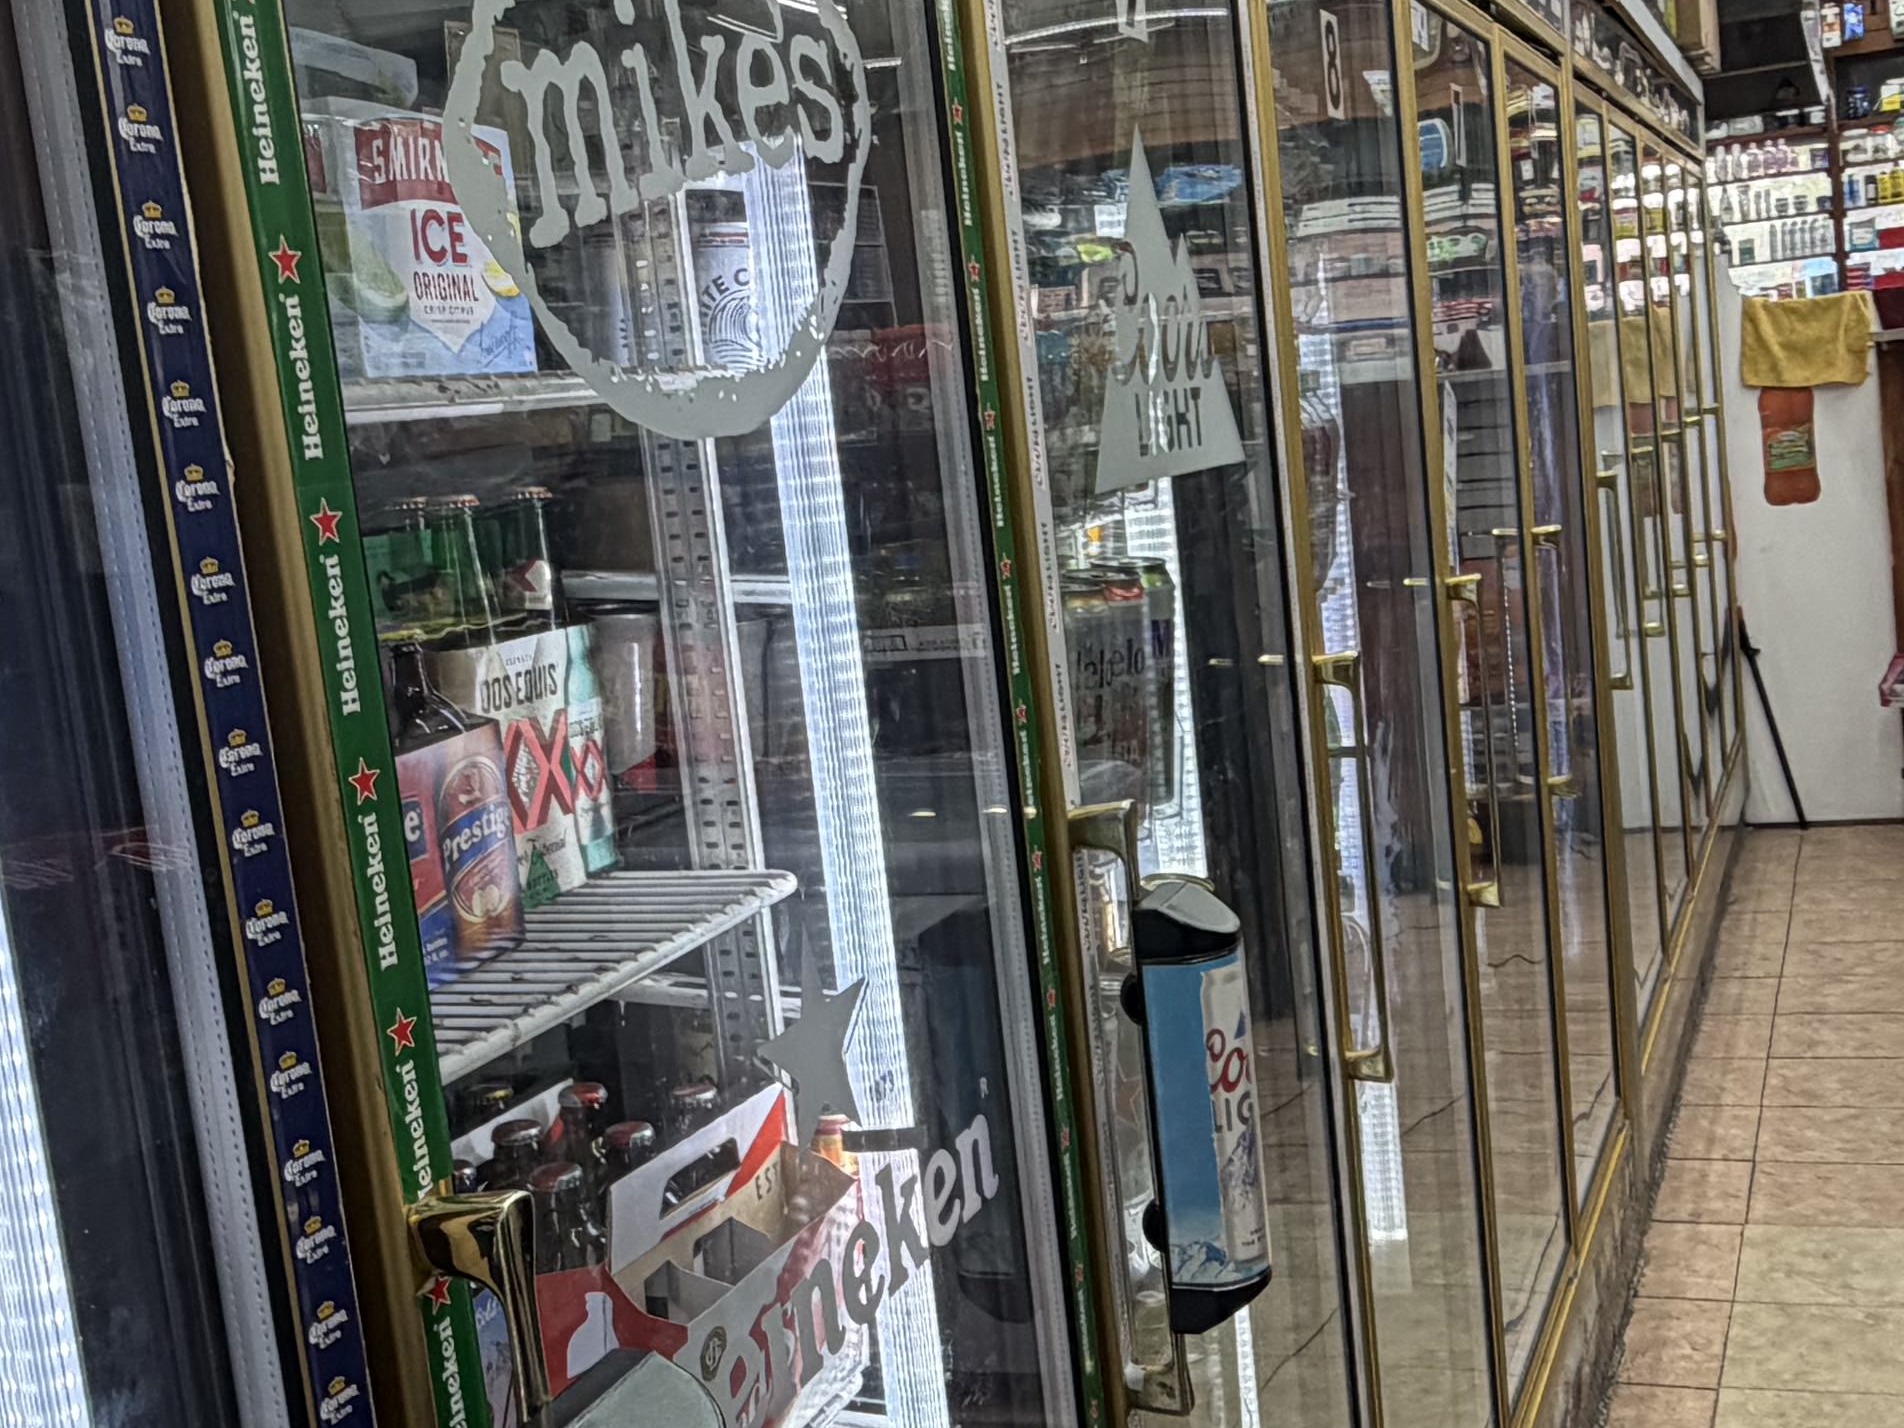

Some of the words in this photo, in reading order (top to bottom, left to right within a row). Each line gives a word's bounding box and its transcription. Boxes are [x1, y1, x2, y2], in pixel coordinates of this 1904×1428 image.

[1324, 20, 1344, 112] 8
[371, 134, 451, 182] SMIRN
[410, 209, 469, 265] ICE
[413, 272, 479, 303] ORIGINAL
[191, 566, 234, 596] Corona
[321, 552, 362, 718] Heineken
[480, 672, 513, 714] DOS
[516, 663, 559, 707] EQUIS
